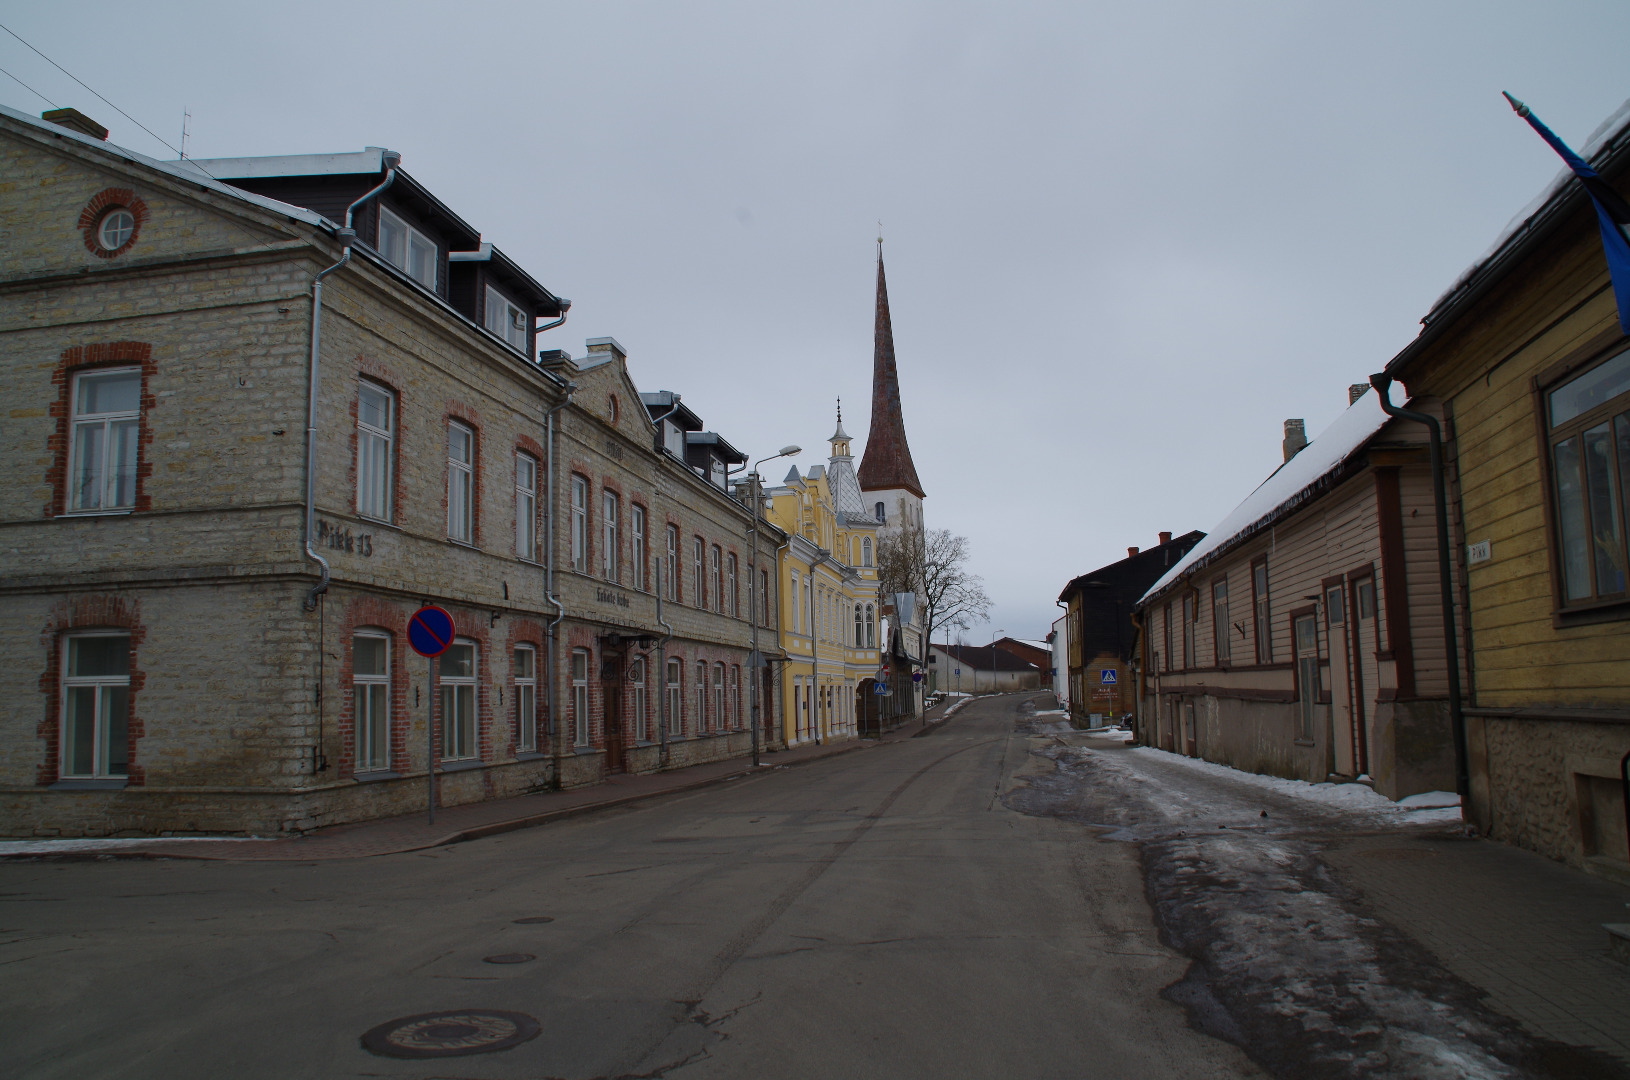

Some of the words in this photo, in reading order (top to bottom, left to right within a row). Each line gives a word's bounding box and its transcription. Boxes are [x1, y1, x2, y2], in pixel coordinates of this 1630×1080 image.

[318, 519, 354, 552] Pikk
[357, 533, 373, 557] 13
[1472, 545, 1486, 559] Pikk
